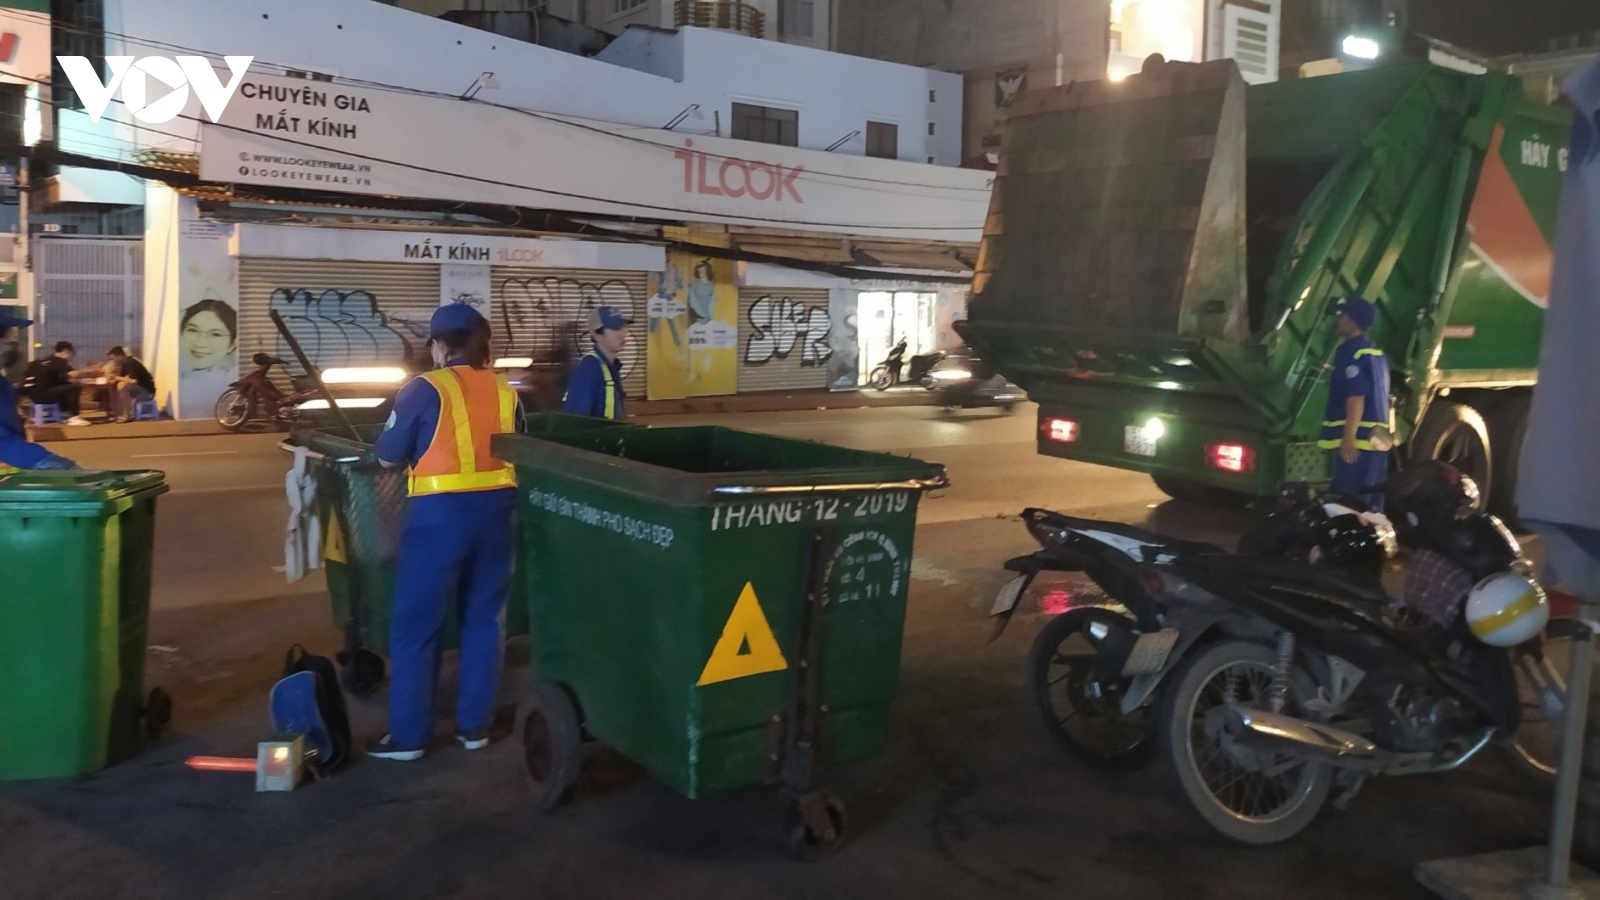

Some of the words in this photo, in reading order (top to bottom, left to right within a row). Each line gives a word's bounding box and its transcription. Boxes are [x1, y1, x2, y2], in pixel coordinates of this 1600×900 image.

[240, 82, 327, 107] CHUYÊN
[334, 94, 371, 113] GIA
[256, 108, 301, 132] MẮT
[308, 117, 357, 139] KÍNH
[404, 238, 443, 259] MẮT
[448, 242, 490, 260] KÍNH
